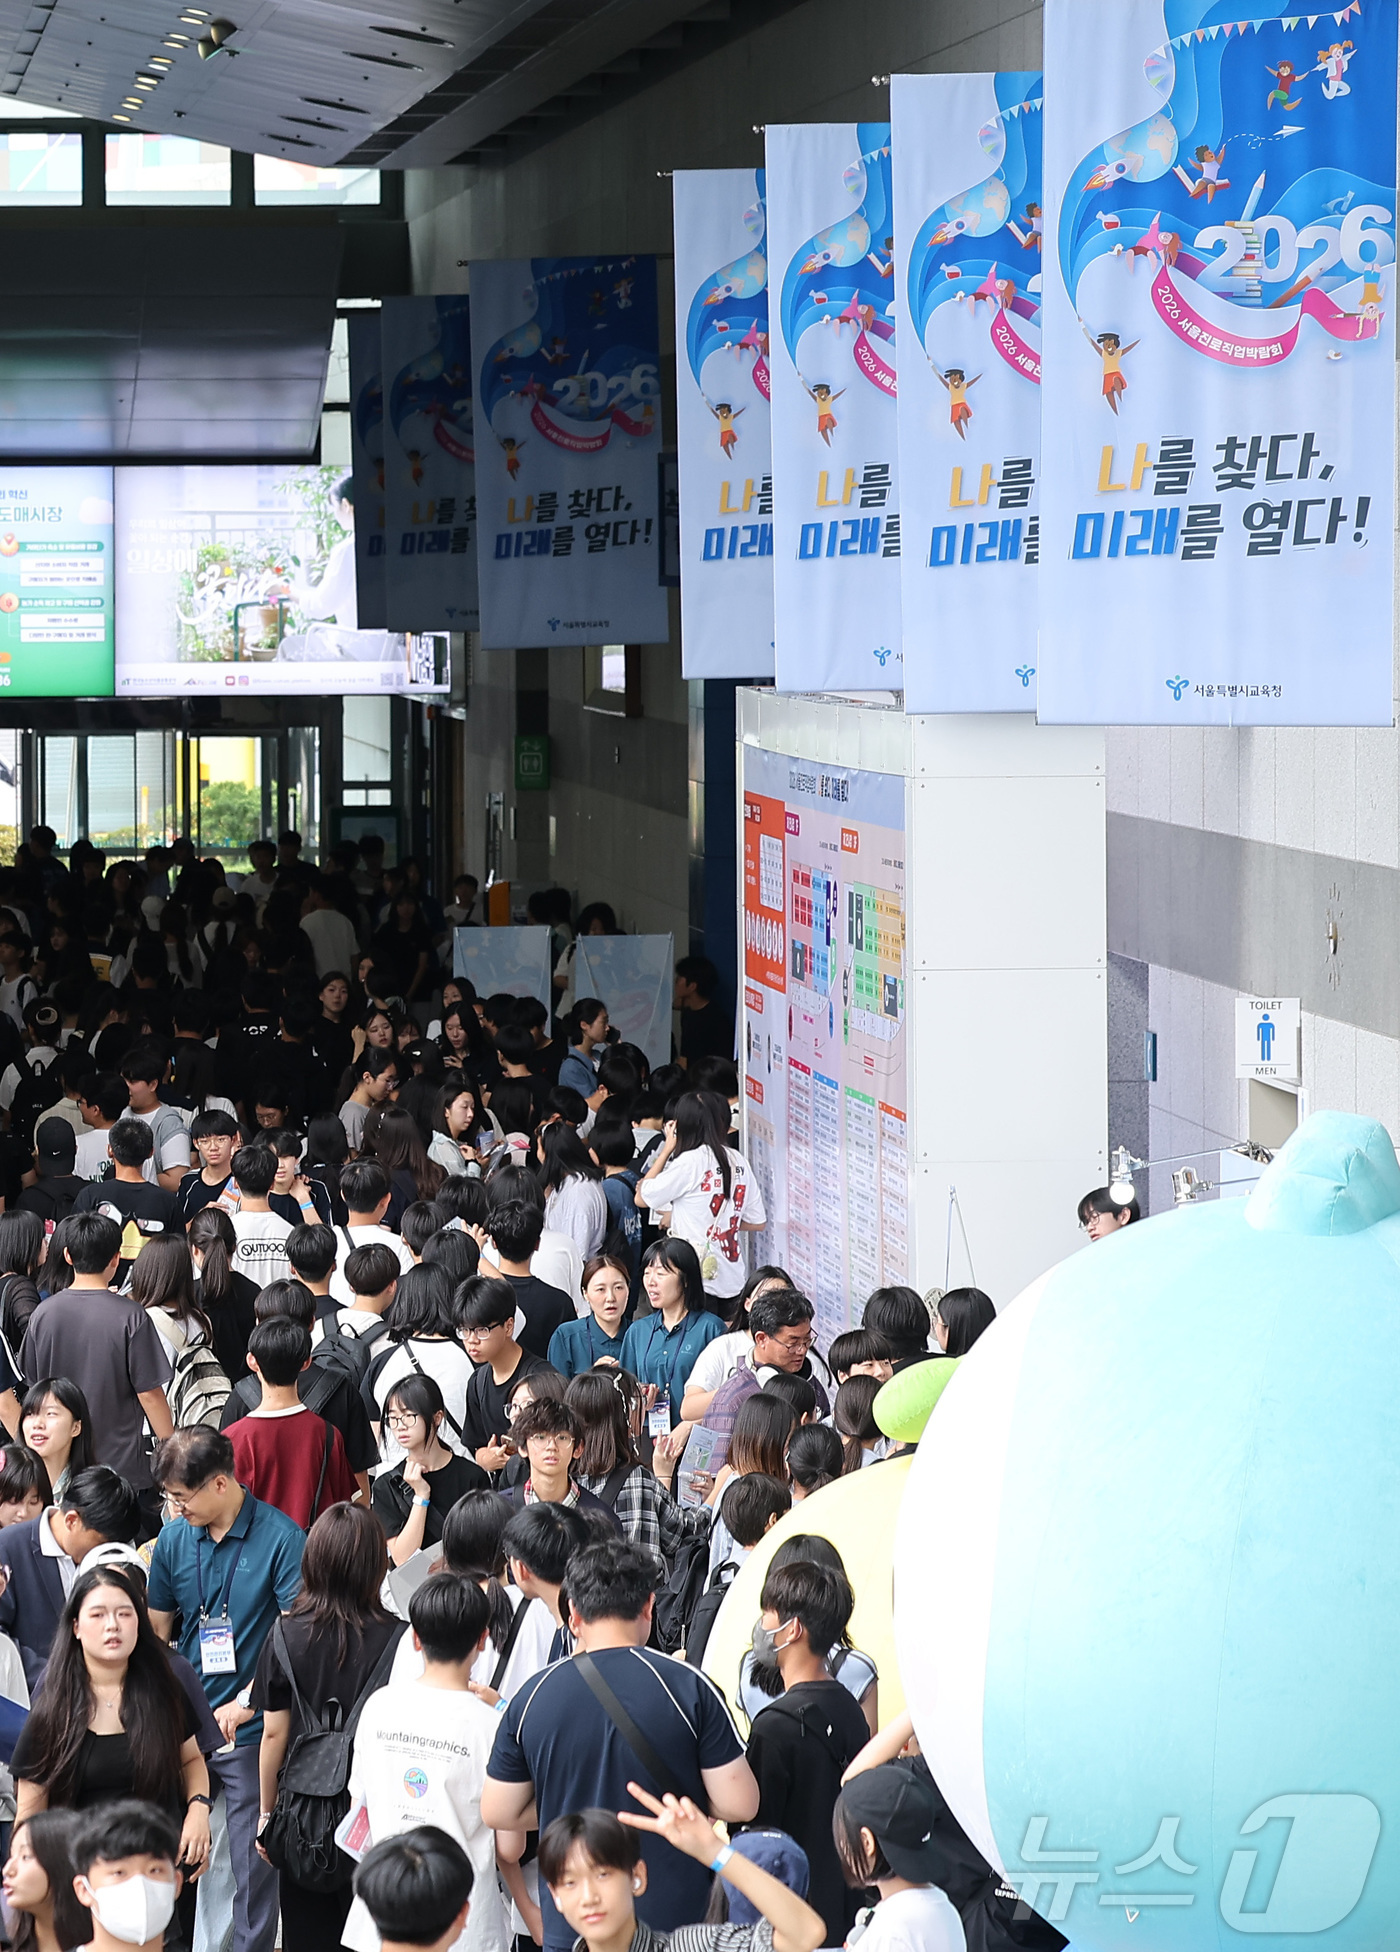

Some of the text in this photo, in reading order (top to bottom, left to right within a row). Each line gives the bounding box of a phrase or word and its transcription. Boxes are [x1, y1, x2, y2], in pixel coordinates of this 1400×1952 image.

[1193, 204, 1395, 298] 2026
[1157, 285, 1284, 359] 2026 서울진로직업박람회
[995, 325, 1018, 355] 2026
[857, 345, 877, 372] 2026
[552, 363, 660, 413] 2026
[1097, 432, 1335, 496] 나를 찾다,
[816, 461, 893, 509] 나를
[949, 457, 1036, 510] 나를
[0, 506, 63, 522] 도매시장
[411, 497, 456, 525] 나를
[507, 491, 559, 525] 나를
[567, 485, 634, 519] 찾다,
[400, 527, 470, 555] 미래를
[494, 518, 653, 560] 미래를 열다!
[1070, 496, 1371, 562] 미래를 열다!
[126, 548, 199, 574] 일상에
[1193, 684, 1282, 698] 서울특별시교육청
[1249, 1001, 1283, 1010] TOILET
[1255, 1067, 1277, 1075] MEN
